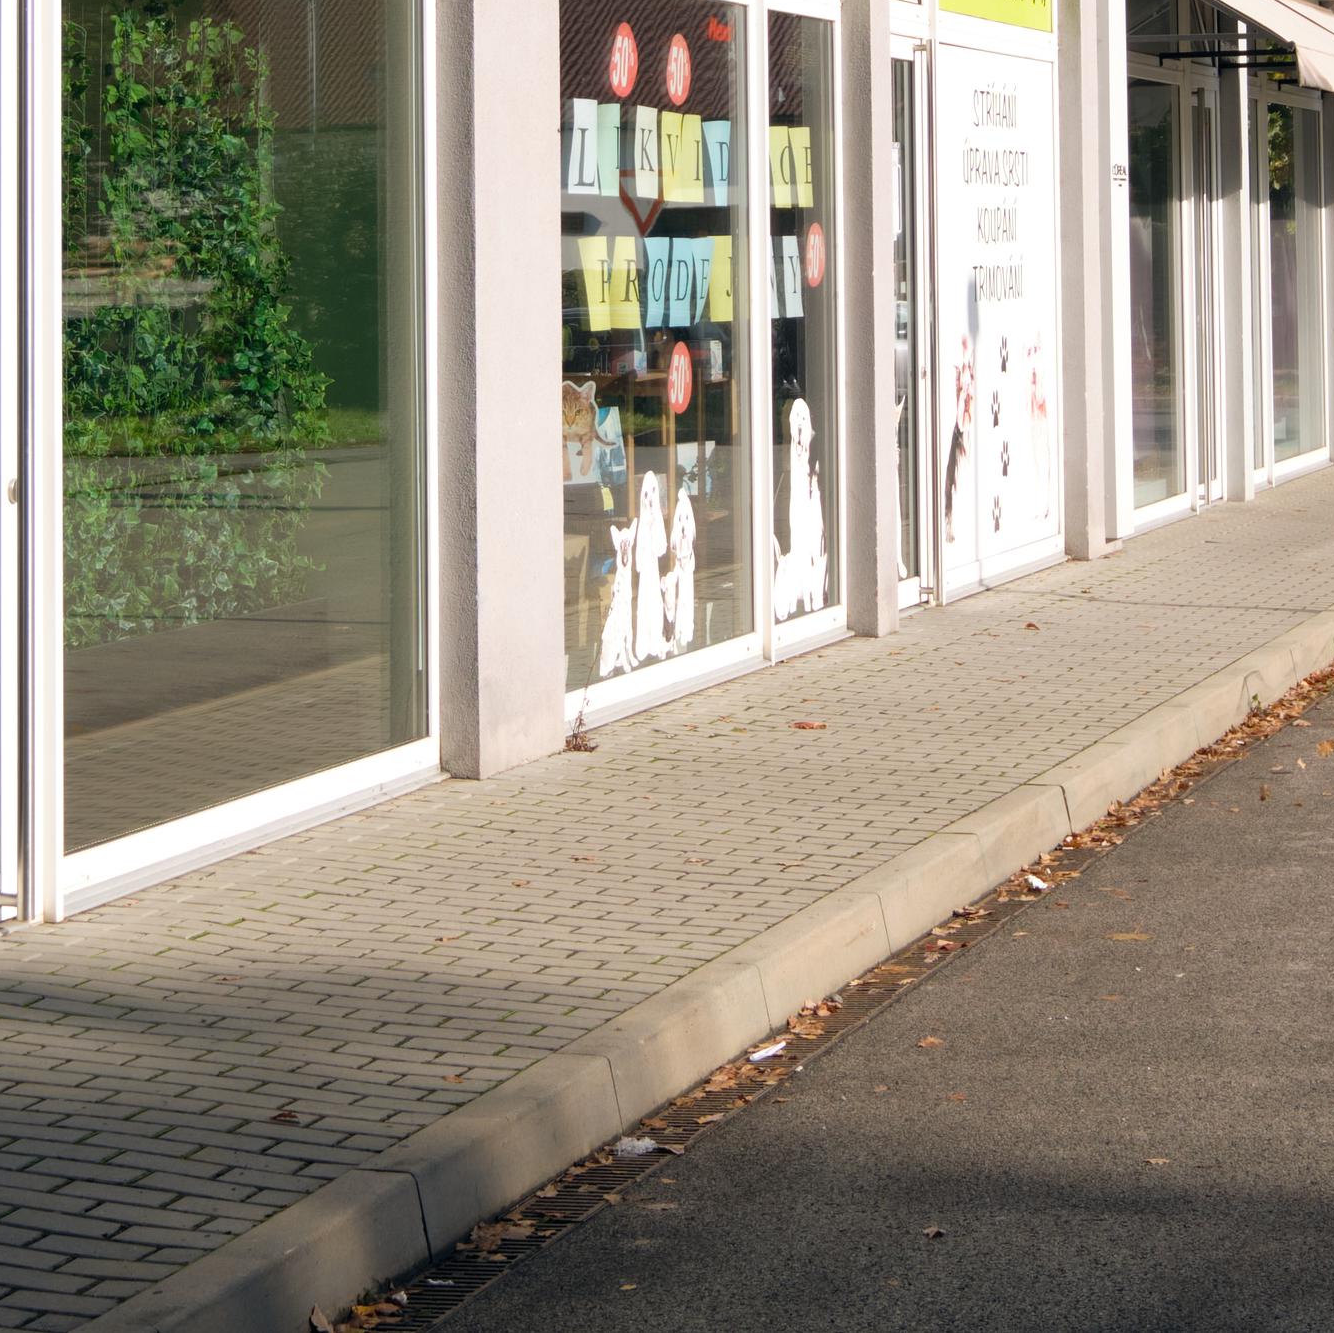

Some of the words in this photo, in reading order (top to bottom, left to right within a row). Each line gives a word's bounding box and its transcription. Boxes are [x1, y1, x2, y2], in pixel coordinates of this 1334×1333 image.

[962, 137, 1001, 185] ÚPRAVA
[1002, 148, 1029, 187] SRSTI
[976, 195, 1018, 244] KOUPÁNÍ
[972, 253, 1024, 303] TRIMOVÁNÍ
